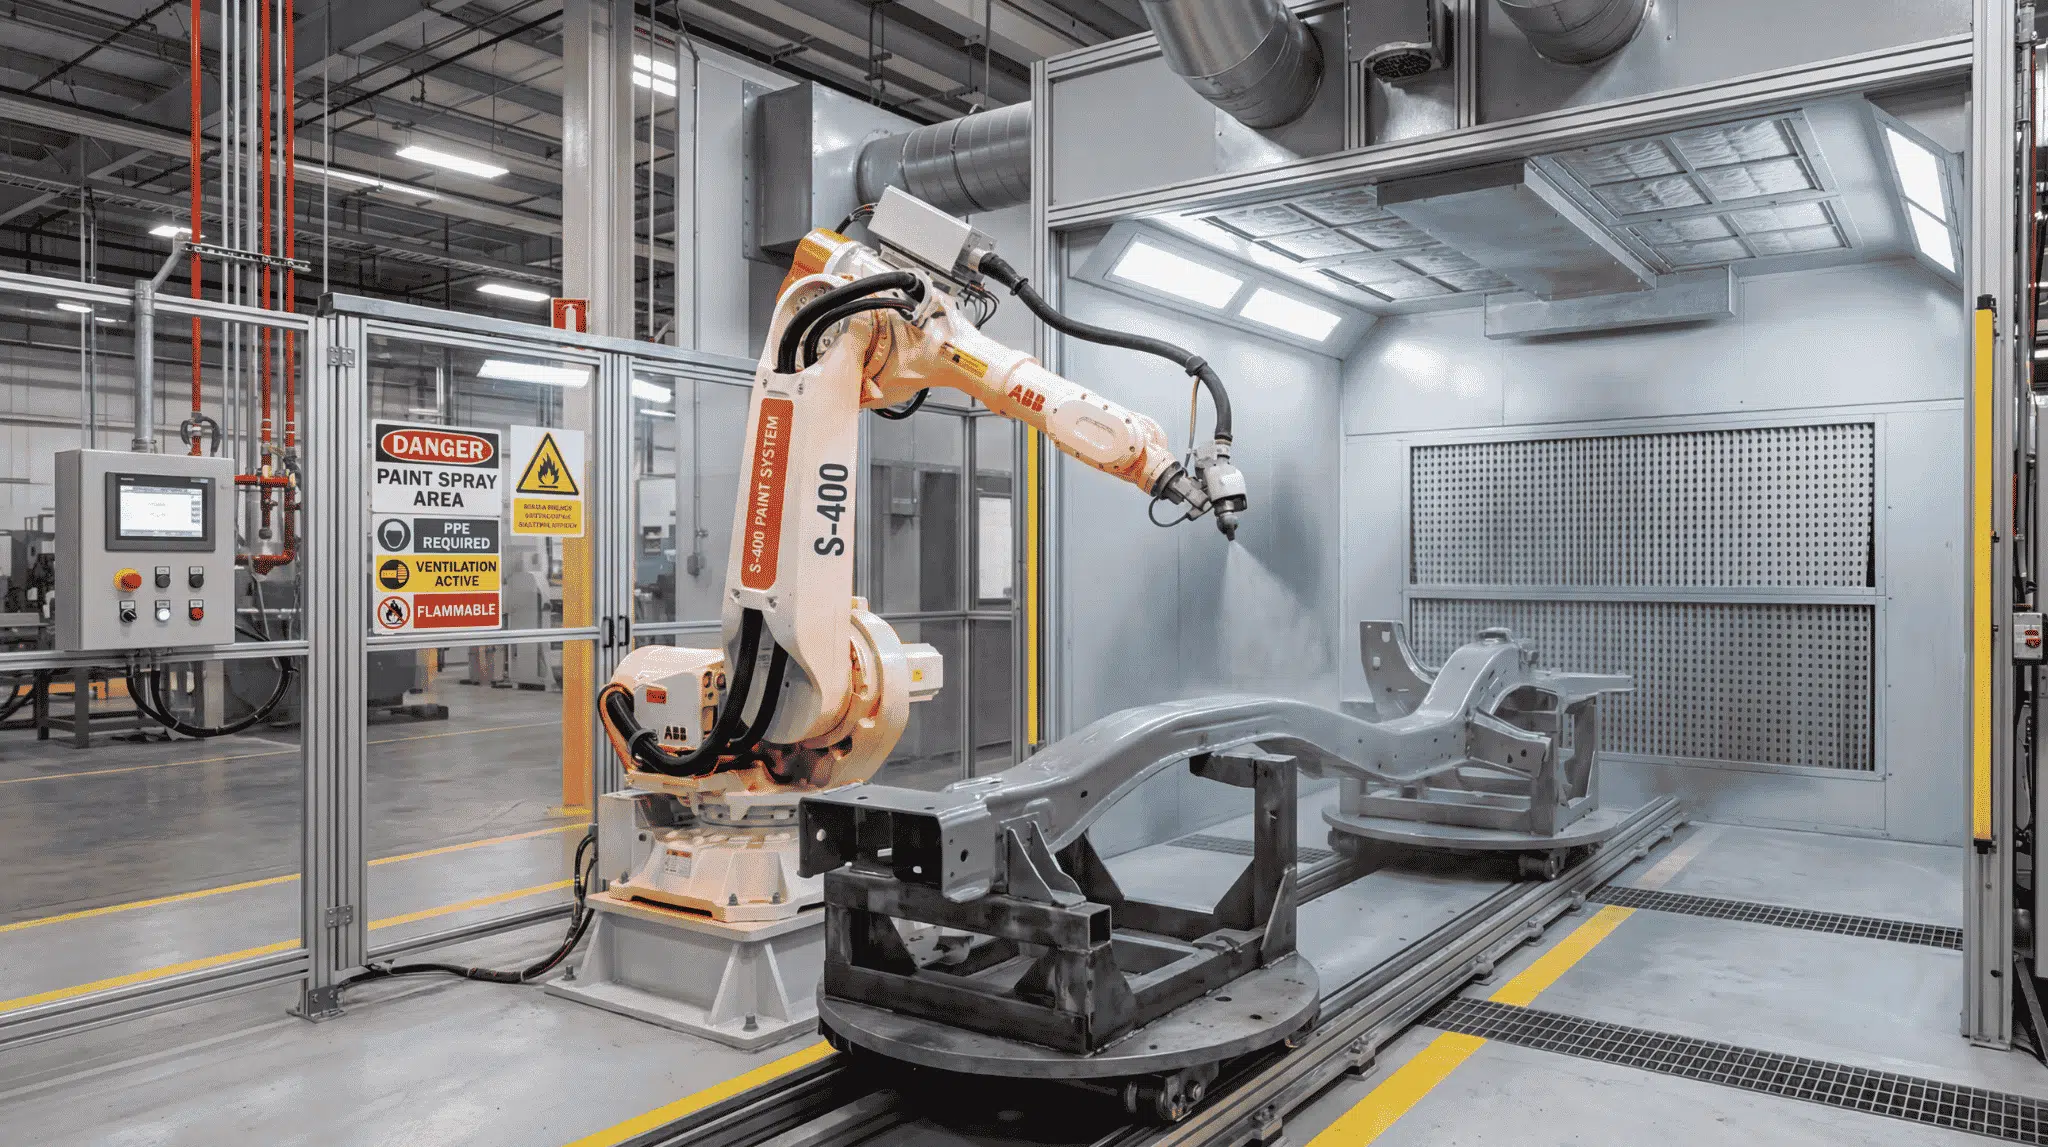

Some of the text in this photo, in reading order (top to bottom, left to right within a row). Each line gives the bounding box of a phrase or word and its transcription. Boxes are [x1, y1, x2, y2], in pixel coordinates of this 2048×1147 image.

[1008, 384, 1046, 412] ABB
[392, 434, 484, 460] DANGER
[377, 468, 498, 489] PAINT SPRAY
[413, 491, 464, 508] AREA
[750, 415, 779, 574] S-400 PAINT SYSTEM
[814, 463, 849, 556] S-400
[444, 522, 470, 535] PPE
[423, 537, 491, 550] REQUIRED
[416, 561, 497, 573] VENTILATION
[435, 575, 479, 587] ACTIVE
[416, 603, 496, 618] FLAMMABLE
[664, 726, 686, 741] ABB
